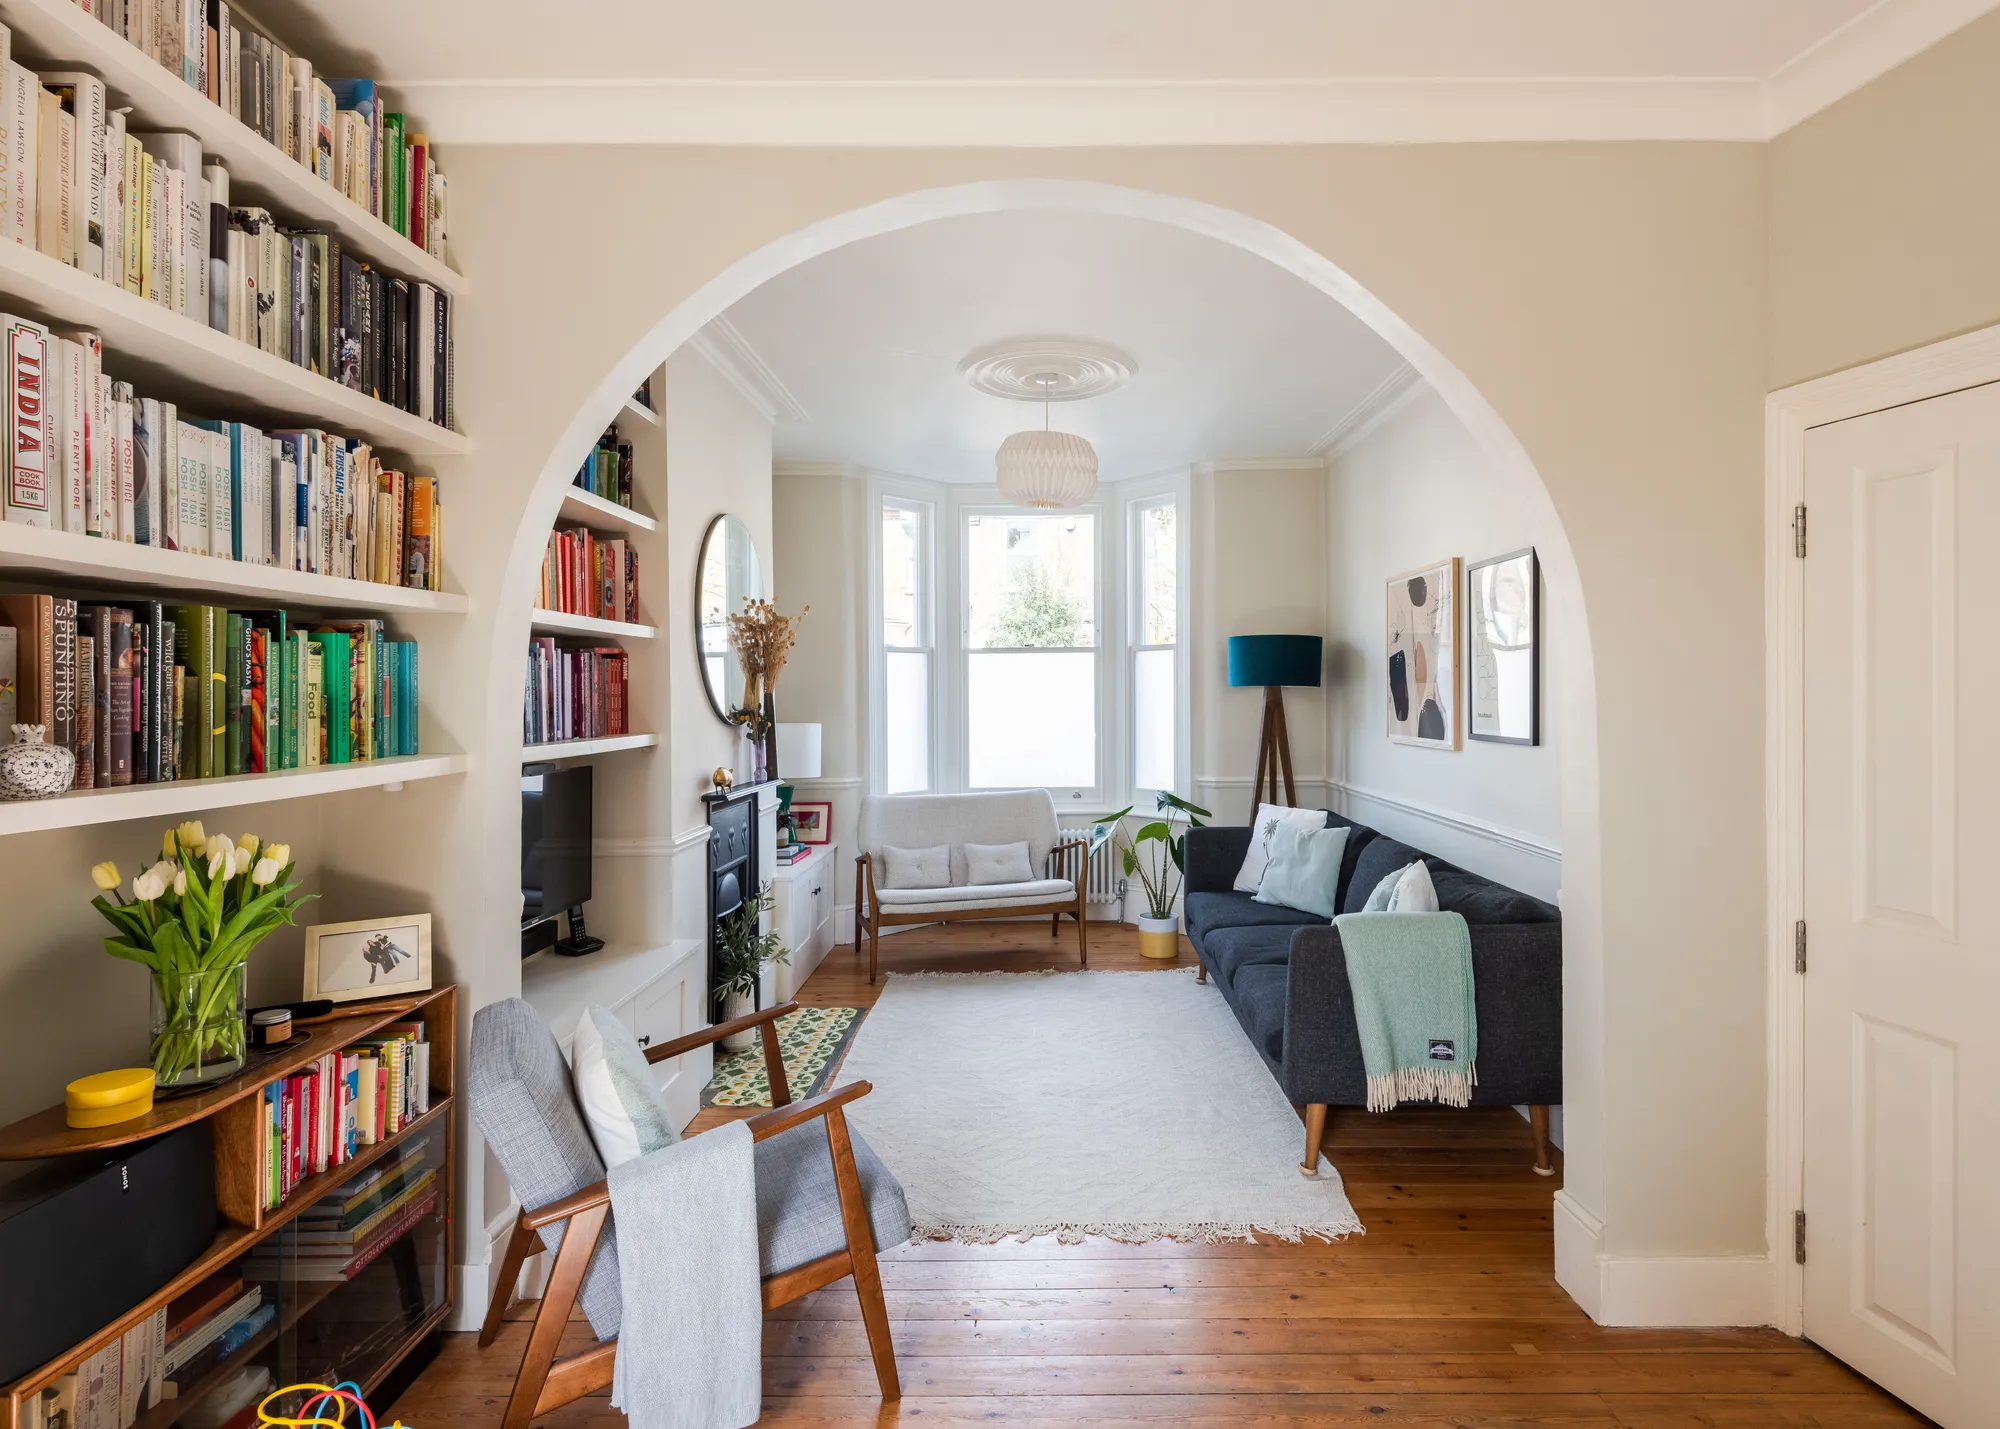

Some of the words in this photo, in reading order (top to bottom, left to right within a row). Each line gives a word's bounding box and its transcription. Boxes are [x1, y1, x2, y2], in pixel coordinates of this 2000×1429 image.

[16, 75, 25, 116] NIGELLA
[319, 95, 329, 126] white
[91, 84, 100, 140] COOKING
[16, 120, 25, 163] LAWSON
[61, 126, 70, 175] DOMESTIC
[91, 143, 99, 163] FOR
[319, 152, 329, 181] teeth
[16, 170, 24, 195] HOW
[90, 166, 99, 217] FRIENDS
[16, 197, 24, 209] TO
[60, 177, 69, 232] ALCHEMIST
[16, 211, 24, 227] EAT
[294, 296, 302, 321] Things
[18, 352, 41, 454] INDIA
[124, 439, 132, 475] POSH
[180, 456, 188, 489] POSH
[335, 445, 344, 494] JERUSALEM
[19, 471, 40, 480] COOK
[19, 477, 40, 486] BOOK
[189, 459, 197, 492] POSH
[199, 462, 207, 495] POSH
[223, 468, 231, 500] POSH
[21, 490, 39, 501] 1.5KG
[123, 481, 133, 504] RICE
[180, 496, 189, 525] TOAST
[199, 502, 207, 529] TOAST
[215, 505, 223, 532] TOAST
[223, 507, 231, 532] TOAST
[44, 605, 52, 633] CRAZY
[44, 634, 52, 661] WATER
[55, 605, 67, 721] SPUNTINO
[165, 638, 174, 663] wild
[44, 663, 52, 697] PICKLED
[80, 642, 90, 703] HAMBURGER
[308, 682, 317, 719] Food
[121, 1166, 129, 1190] SONOS
[355, 1231, 396, 1269] OTTOLENGHI
[398, 1208, 424, 1231] FLAVOUR
